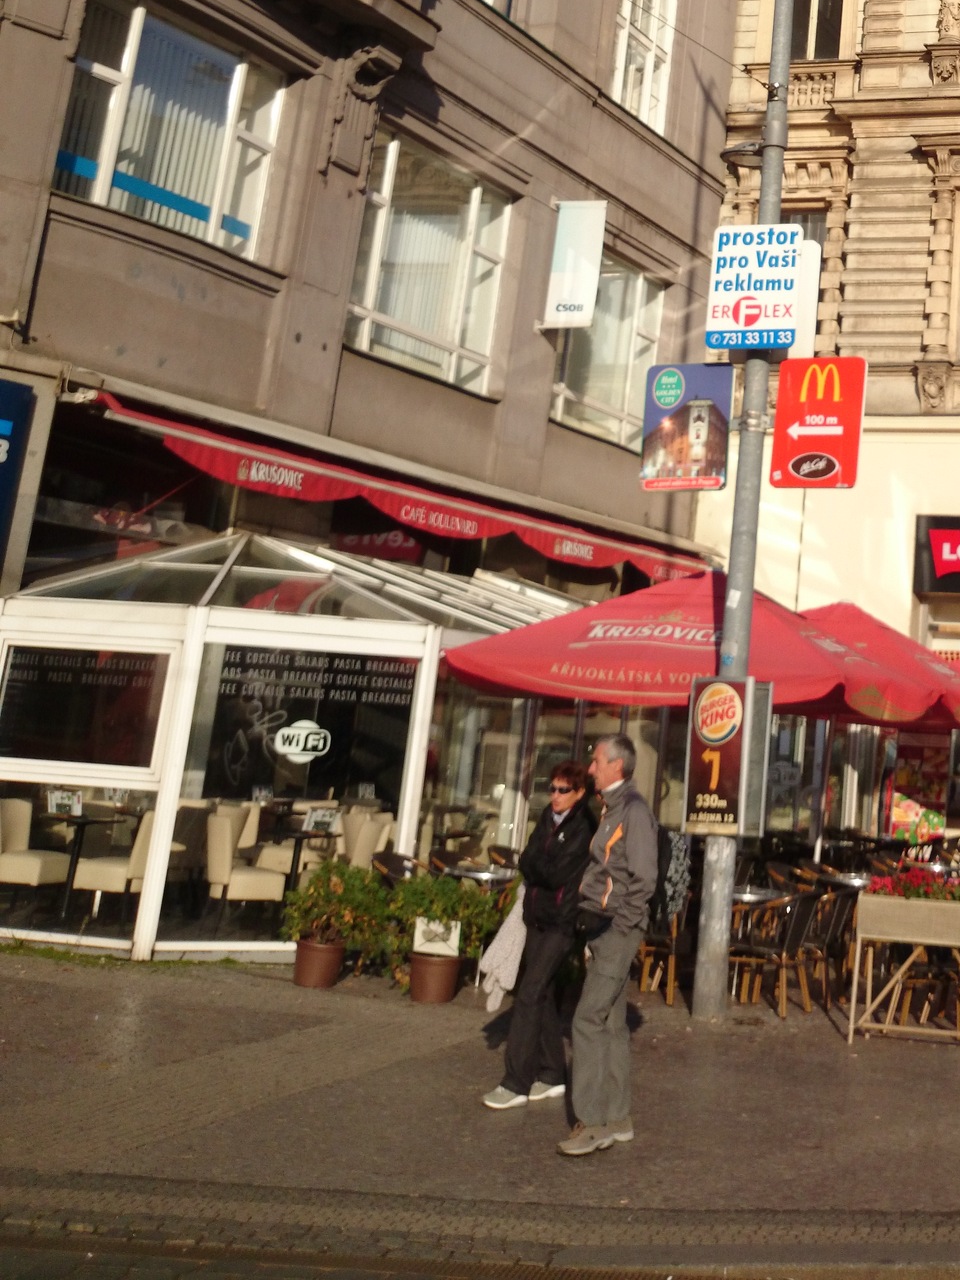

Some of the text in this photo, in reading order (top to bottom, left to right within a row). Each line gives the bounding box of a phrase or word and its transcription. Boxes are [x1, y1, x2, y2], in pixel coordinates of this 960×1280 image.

[718, 228, 799, 252] prostor
[716, 248, 797, 274] pro Vaši
[714, 273, 794, 292] reklamu
[722, 331, 792, 345] 731 33 11 33
[805, 415, 838, 425] 100 m
[333, 657, 362, 670] PASTA
[366, 660, 418, 674] BREAKFAST
[329, 689, 357, 702] PASTA
[361, 691, 412, 705] BREAKFAST
[700, 695, 735, 715] BURGER
[700, 705, 736, 732] KING
